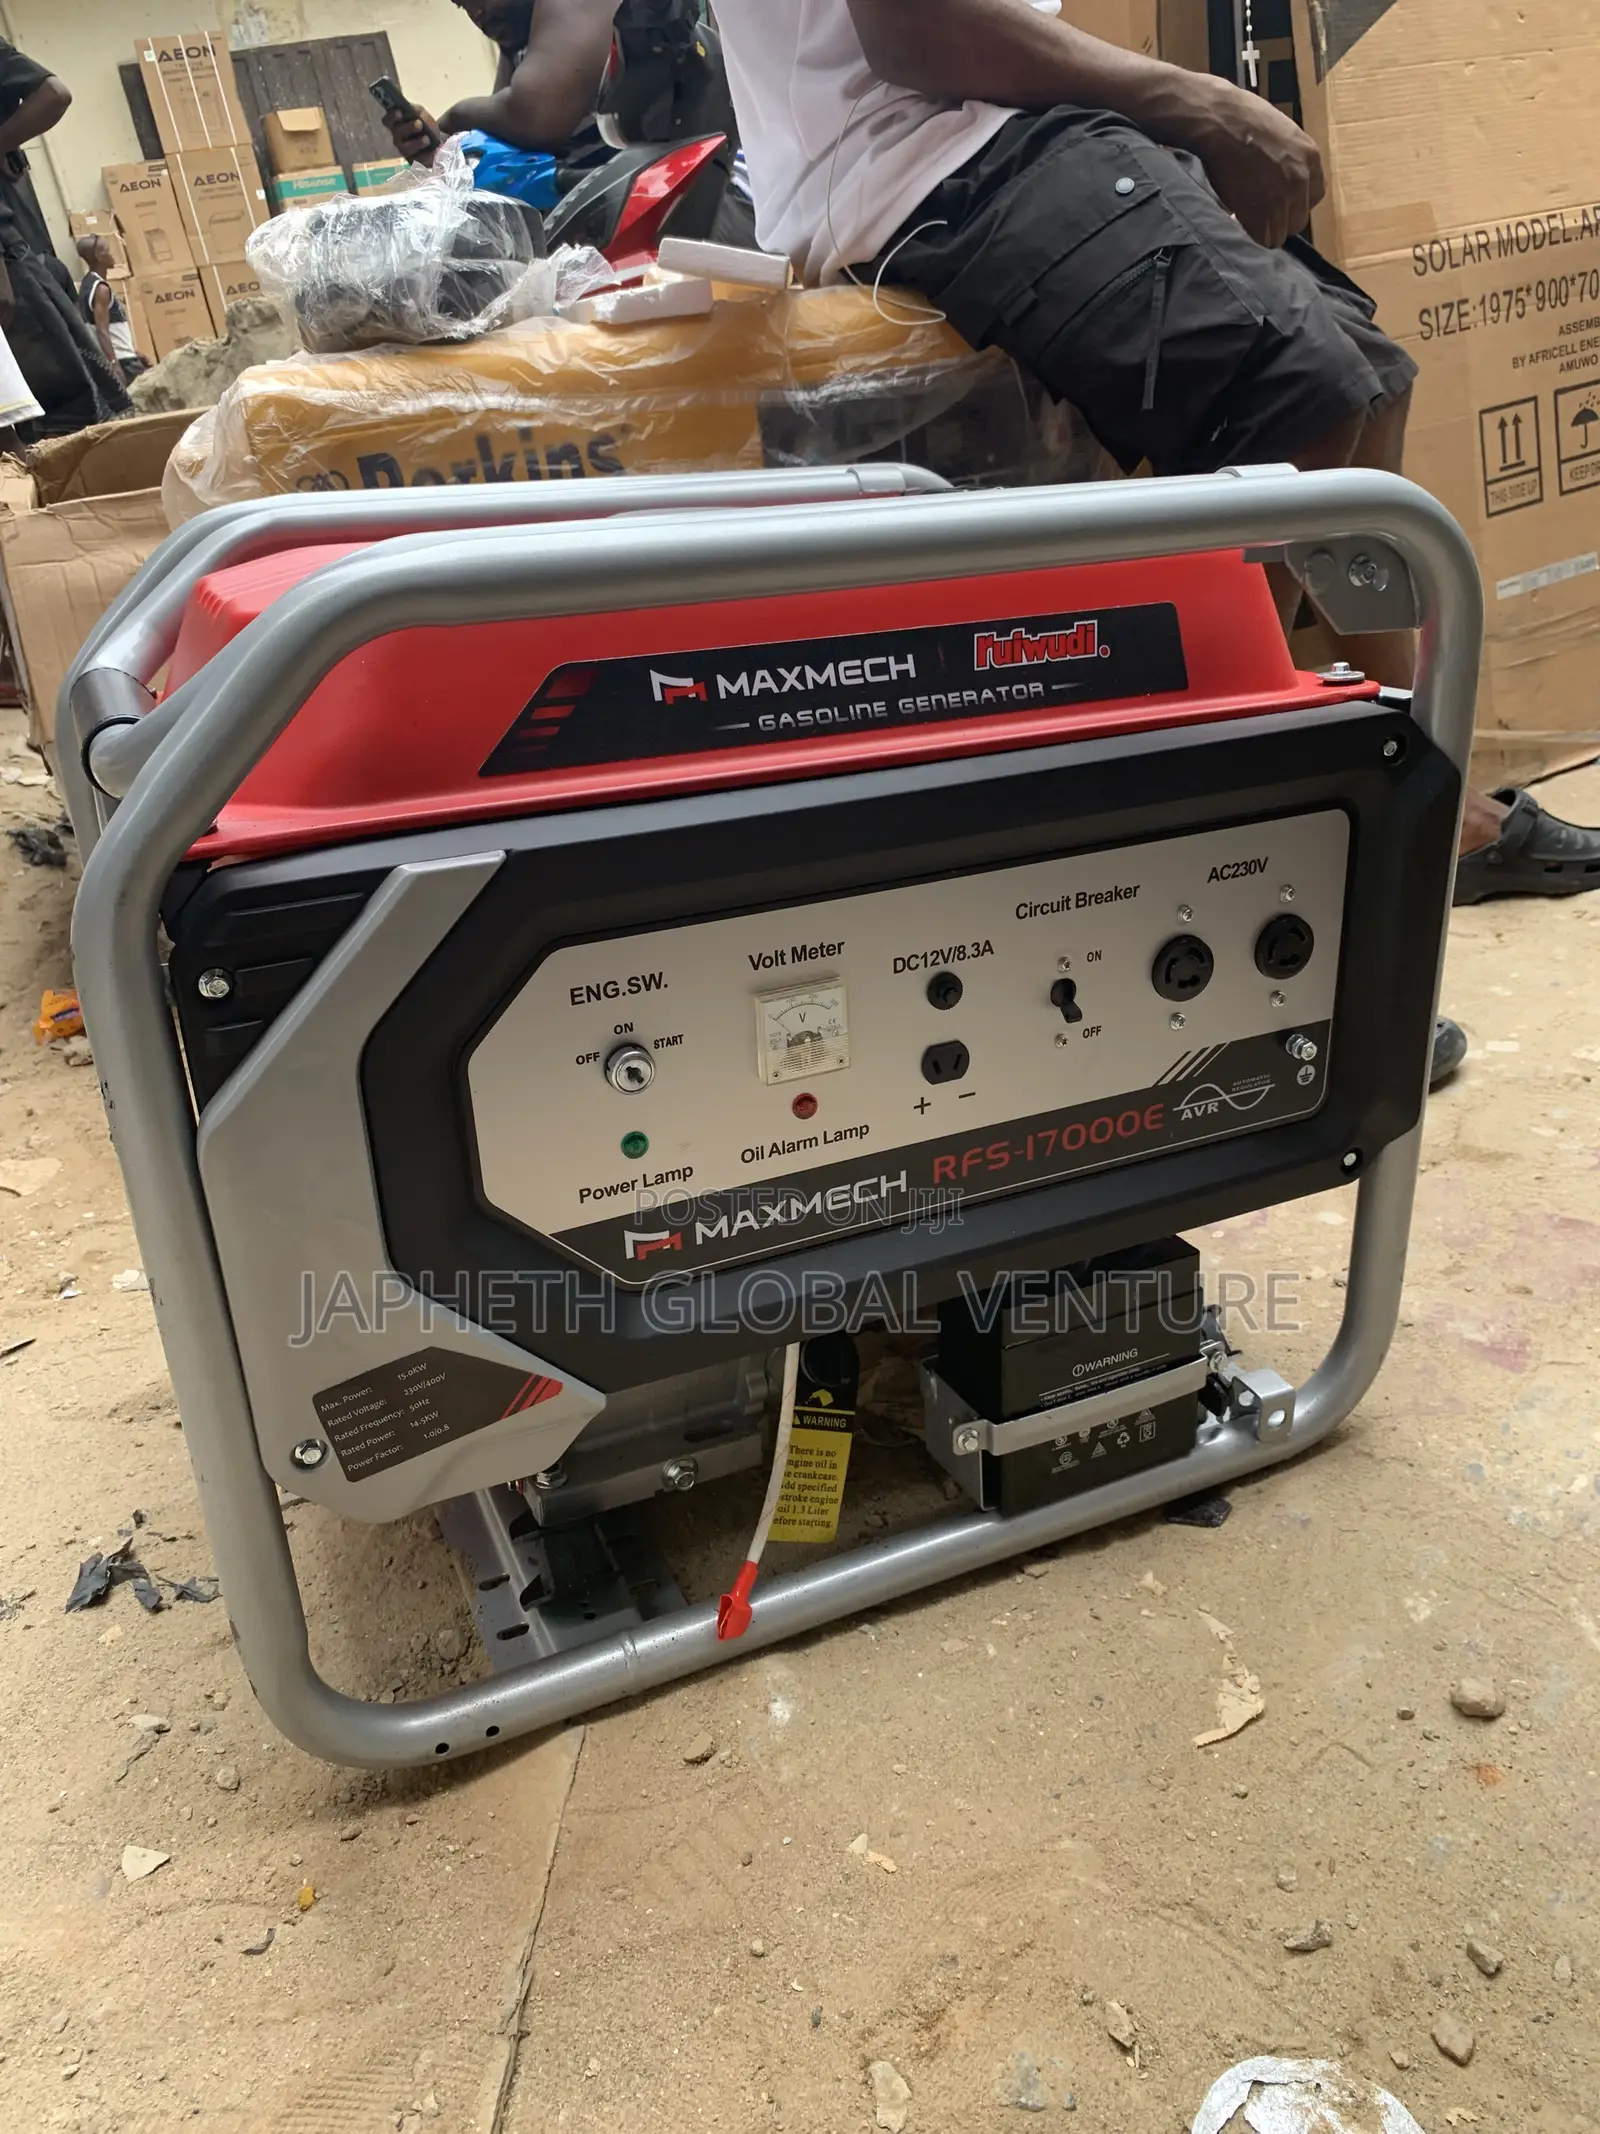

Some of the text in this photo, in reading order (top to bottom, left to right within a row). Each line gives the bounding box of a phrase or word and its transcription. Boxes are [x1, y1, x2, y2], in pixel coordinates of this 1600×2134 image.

[157, 44, 217, 64] AEON
[119, 178, 162, 194] AEON
[193, 172, 241, 188] AEON
[1412, 229, 1492, 277] SOLAR
[154, 289, 196, 304] AEON
[225, 281, 261, 296] AEO
[1512, 354, 1526, 370] BY
[1528, 342, 1578, 366] AFRICELL
[1569, 464, 1590, 482] KEEP
[716, 653, 917, 699] MAXMECH
[758, 682, 1045, 732] GASOLINE GENERATOR
[1207, 857, 1269, 884] AC230V
[1014, 884, 1141, 921] Circuit Breaker
[748, 941, 845, 971] Volt Meter
[892, 938, 995, 975] DC12V/8.3A
[1086, 950, 1102, 963] ON
[569, 971, 668, 1006] ENG.SW.
[798, 1012, 806, 1023] V
[613, 1022, 634, 1035] ON
[1082, 1025, 1102, 1040] OFF
[653, 1034, 684, 1049] START
[575, 1051, 600, 1065] OFF
[1232, 1073, 1271, 1086] AUTOMATIC
[1181, 1102, 1219, 1121] AVR
[740, 1123, 870, 1164] Oil Alarm Lamp
[578, 1165, 694, 1204] Power Lamp
[695, 1169, 907, 1245] MAXMECH
[1085, 1348, 1138, 1372] WARNING
[320, 1363, 427, 1412] Max. Power: 15.0KW
[327, 1373, 446, 1428] Rated Voltage: 230V/400V
[334, 1398, 431, 1442] Rated Frequency: 50Hz
[803, 1415, 847, 1428] WARNING
[340, 1443, 365, 1457] Rated
[366, 1430, 396, 1447] Power:
[347, 1423, 450, 1472] Power Factor: 1.0/0.8
[789, 1445, 814, 1455] There
[816, 1448, 823, 1456] is
[786, 1459, 837, 1469] ngine oil in
[781, 1481, 838, 1492] dd specified
[777, 1504, 829, 1516] oil 1.3 Liter
[810, 1496, 839, 1505] engine
[773, 1517, 797, 1526] efore
